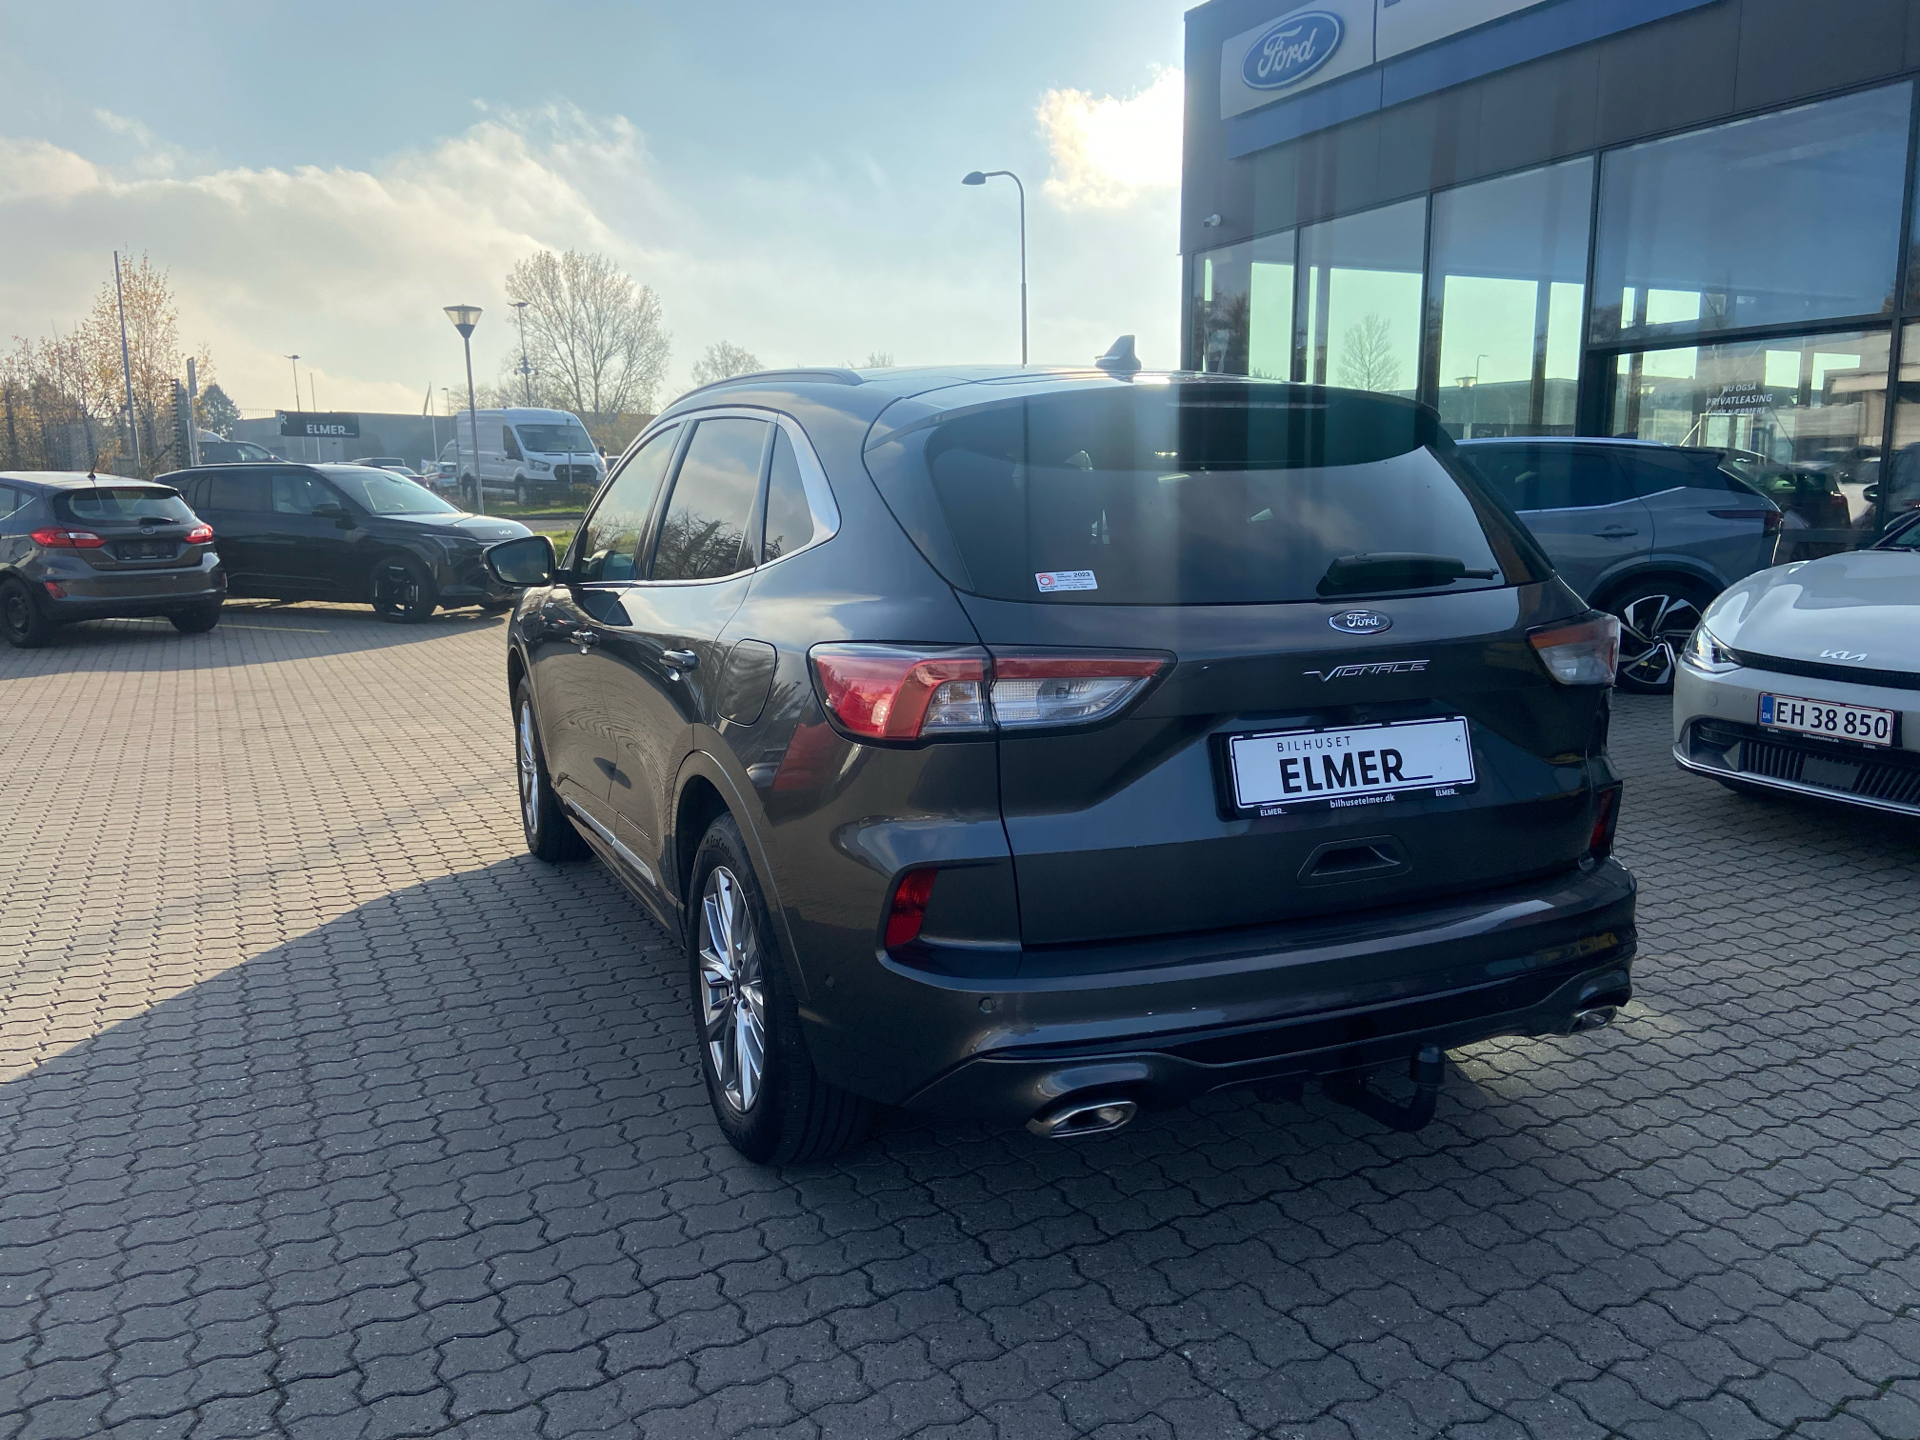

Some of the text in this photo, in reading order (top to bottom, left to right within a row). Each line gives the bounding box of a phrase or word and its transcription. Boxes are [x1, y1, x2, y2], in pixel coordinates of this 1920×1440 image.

[1257, 25, 1318, 78] Ford
[1706, 394, 1773, 406] PRIVATLEASING
[306, 424, 355, 436] ELMER
[1346, 613, 1379, 628] Ford
[1819, 649, 1868, 662] KIA
[1302, 659, 1431, 682] VIGNALE
[1776, 701, 1888, 739] EH 38 850
[1276, 735, 1352, 753] BILHUSET
[1278, 748, 1433, 795] ELMER
[1435, 788, 1459, 797] ELMER
[1329, 793, 1395, 809] bilhusetelmer.dk
[1260, 808, 1287, 817] ELMER
